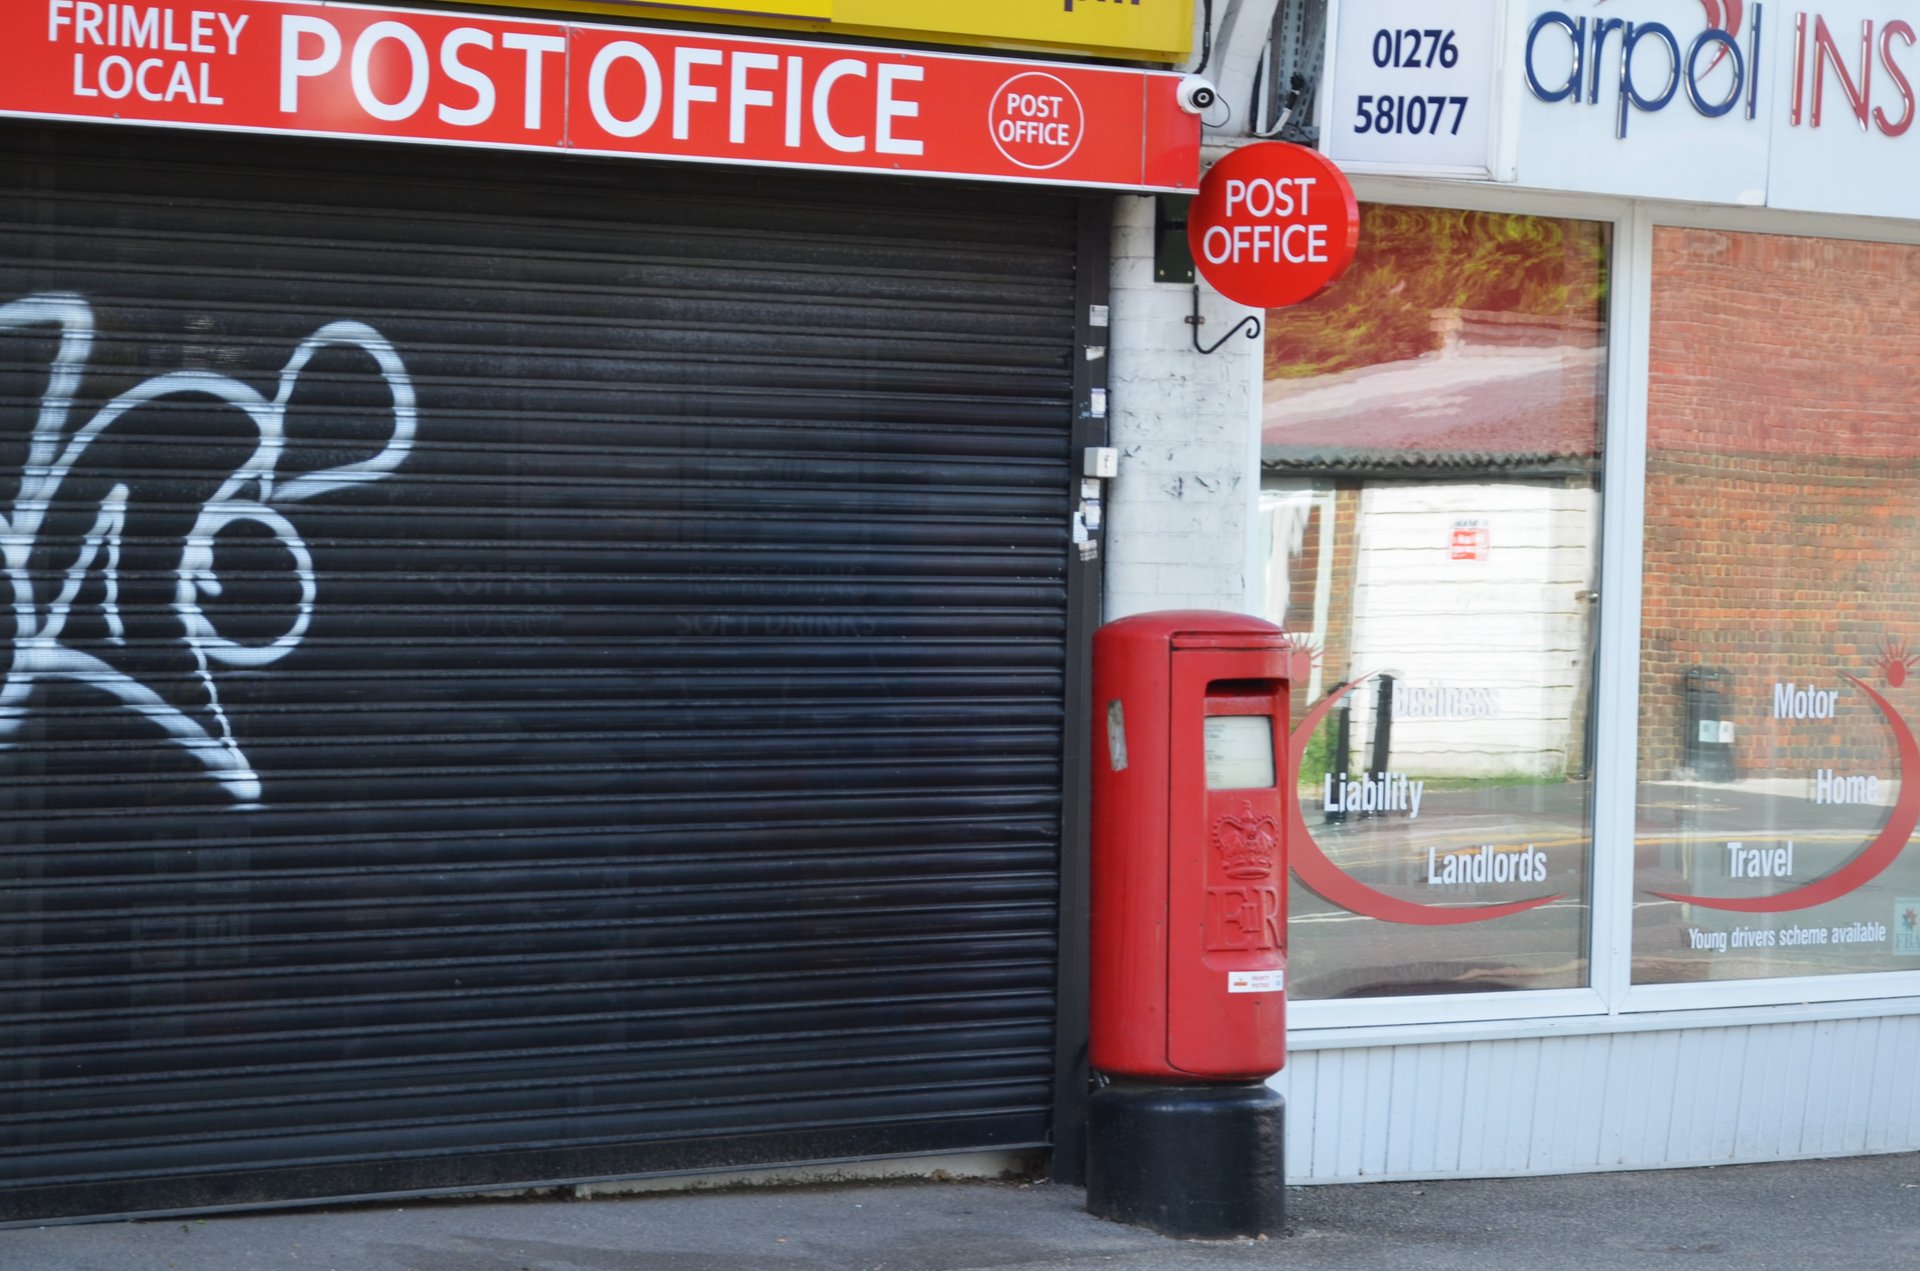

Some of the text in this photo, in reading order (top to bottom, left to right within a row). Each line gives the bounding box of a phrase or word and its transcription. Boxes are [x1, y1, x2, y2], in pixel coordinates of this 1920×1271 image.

[49, 0, 250, 55] FRIMLEY
[1372, 28, 1459, 69] 01276
[73, 53, 224, 105] LOCAL
[279, 13, 924, 156] POST OFFICE
[1791, 11, 1917, 137] INS
[1006, 92, 1063, 119] POST
[1353, 94, 1469, 136] 581077
[998, 120, 1069, 147] OFFICE
[1226, 177, 1317, 218] POST
[1203, 223, 1328, 265] OFFICE
[1773, 683, 1839, 719] Motor
[1324, 772, 1424, 819] Liability
[1816, 768, 1878, 804] Home
[1428, 843, 1548, 884] Landlords
[1727, 840, 1793, 878] Travel
[1689, 921, 1886, 952] Young drivers scheme available
